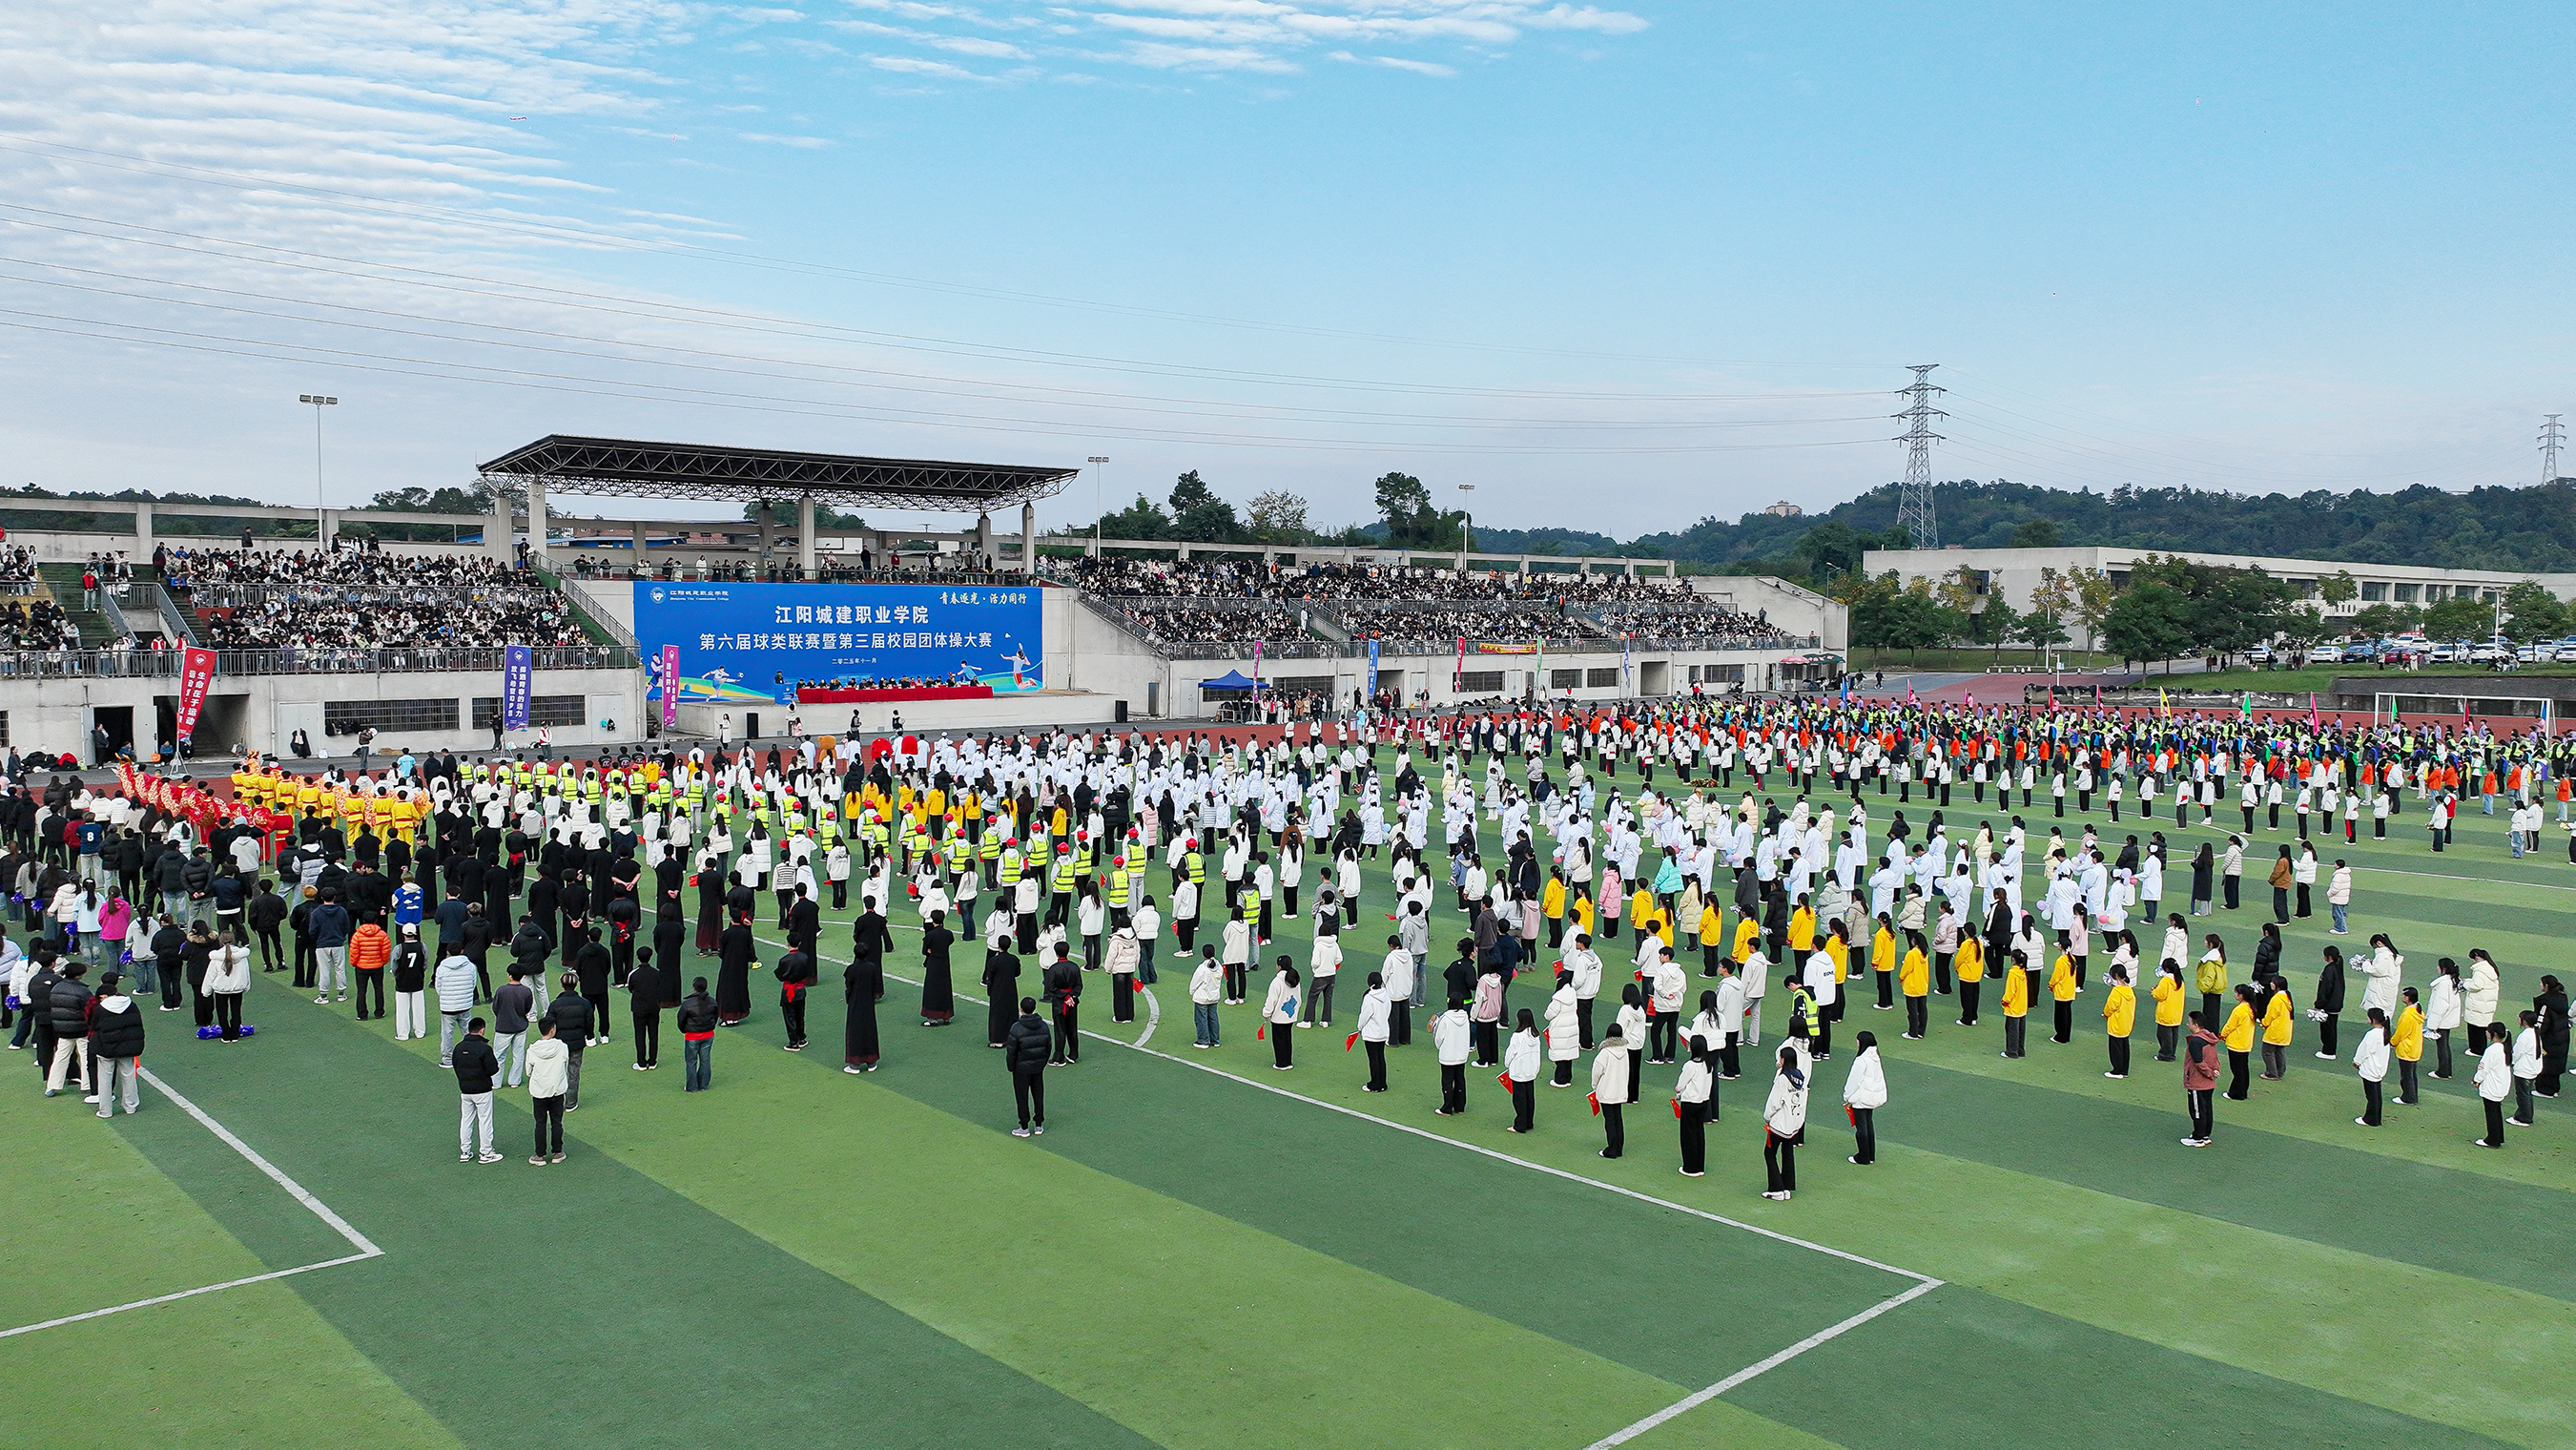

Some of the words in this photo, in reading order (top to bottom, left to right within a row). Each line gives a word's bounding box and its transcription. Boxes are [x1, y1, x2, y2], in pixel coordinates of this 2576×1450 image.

[774, 605, 929, 624] 江阳城建职业学院
[699, 632, 992, 651] 第六届球类联赛暨第三届校园团体操大赛
[185, 672, 206, 725] 生命在于运动
[87, 831, 94, 841] 8
[407, 952, 417, 968] 7
